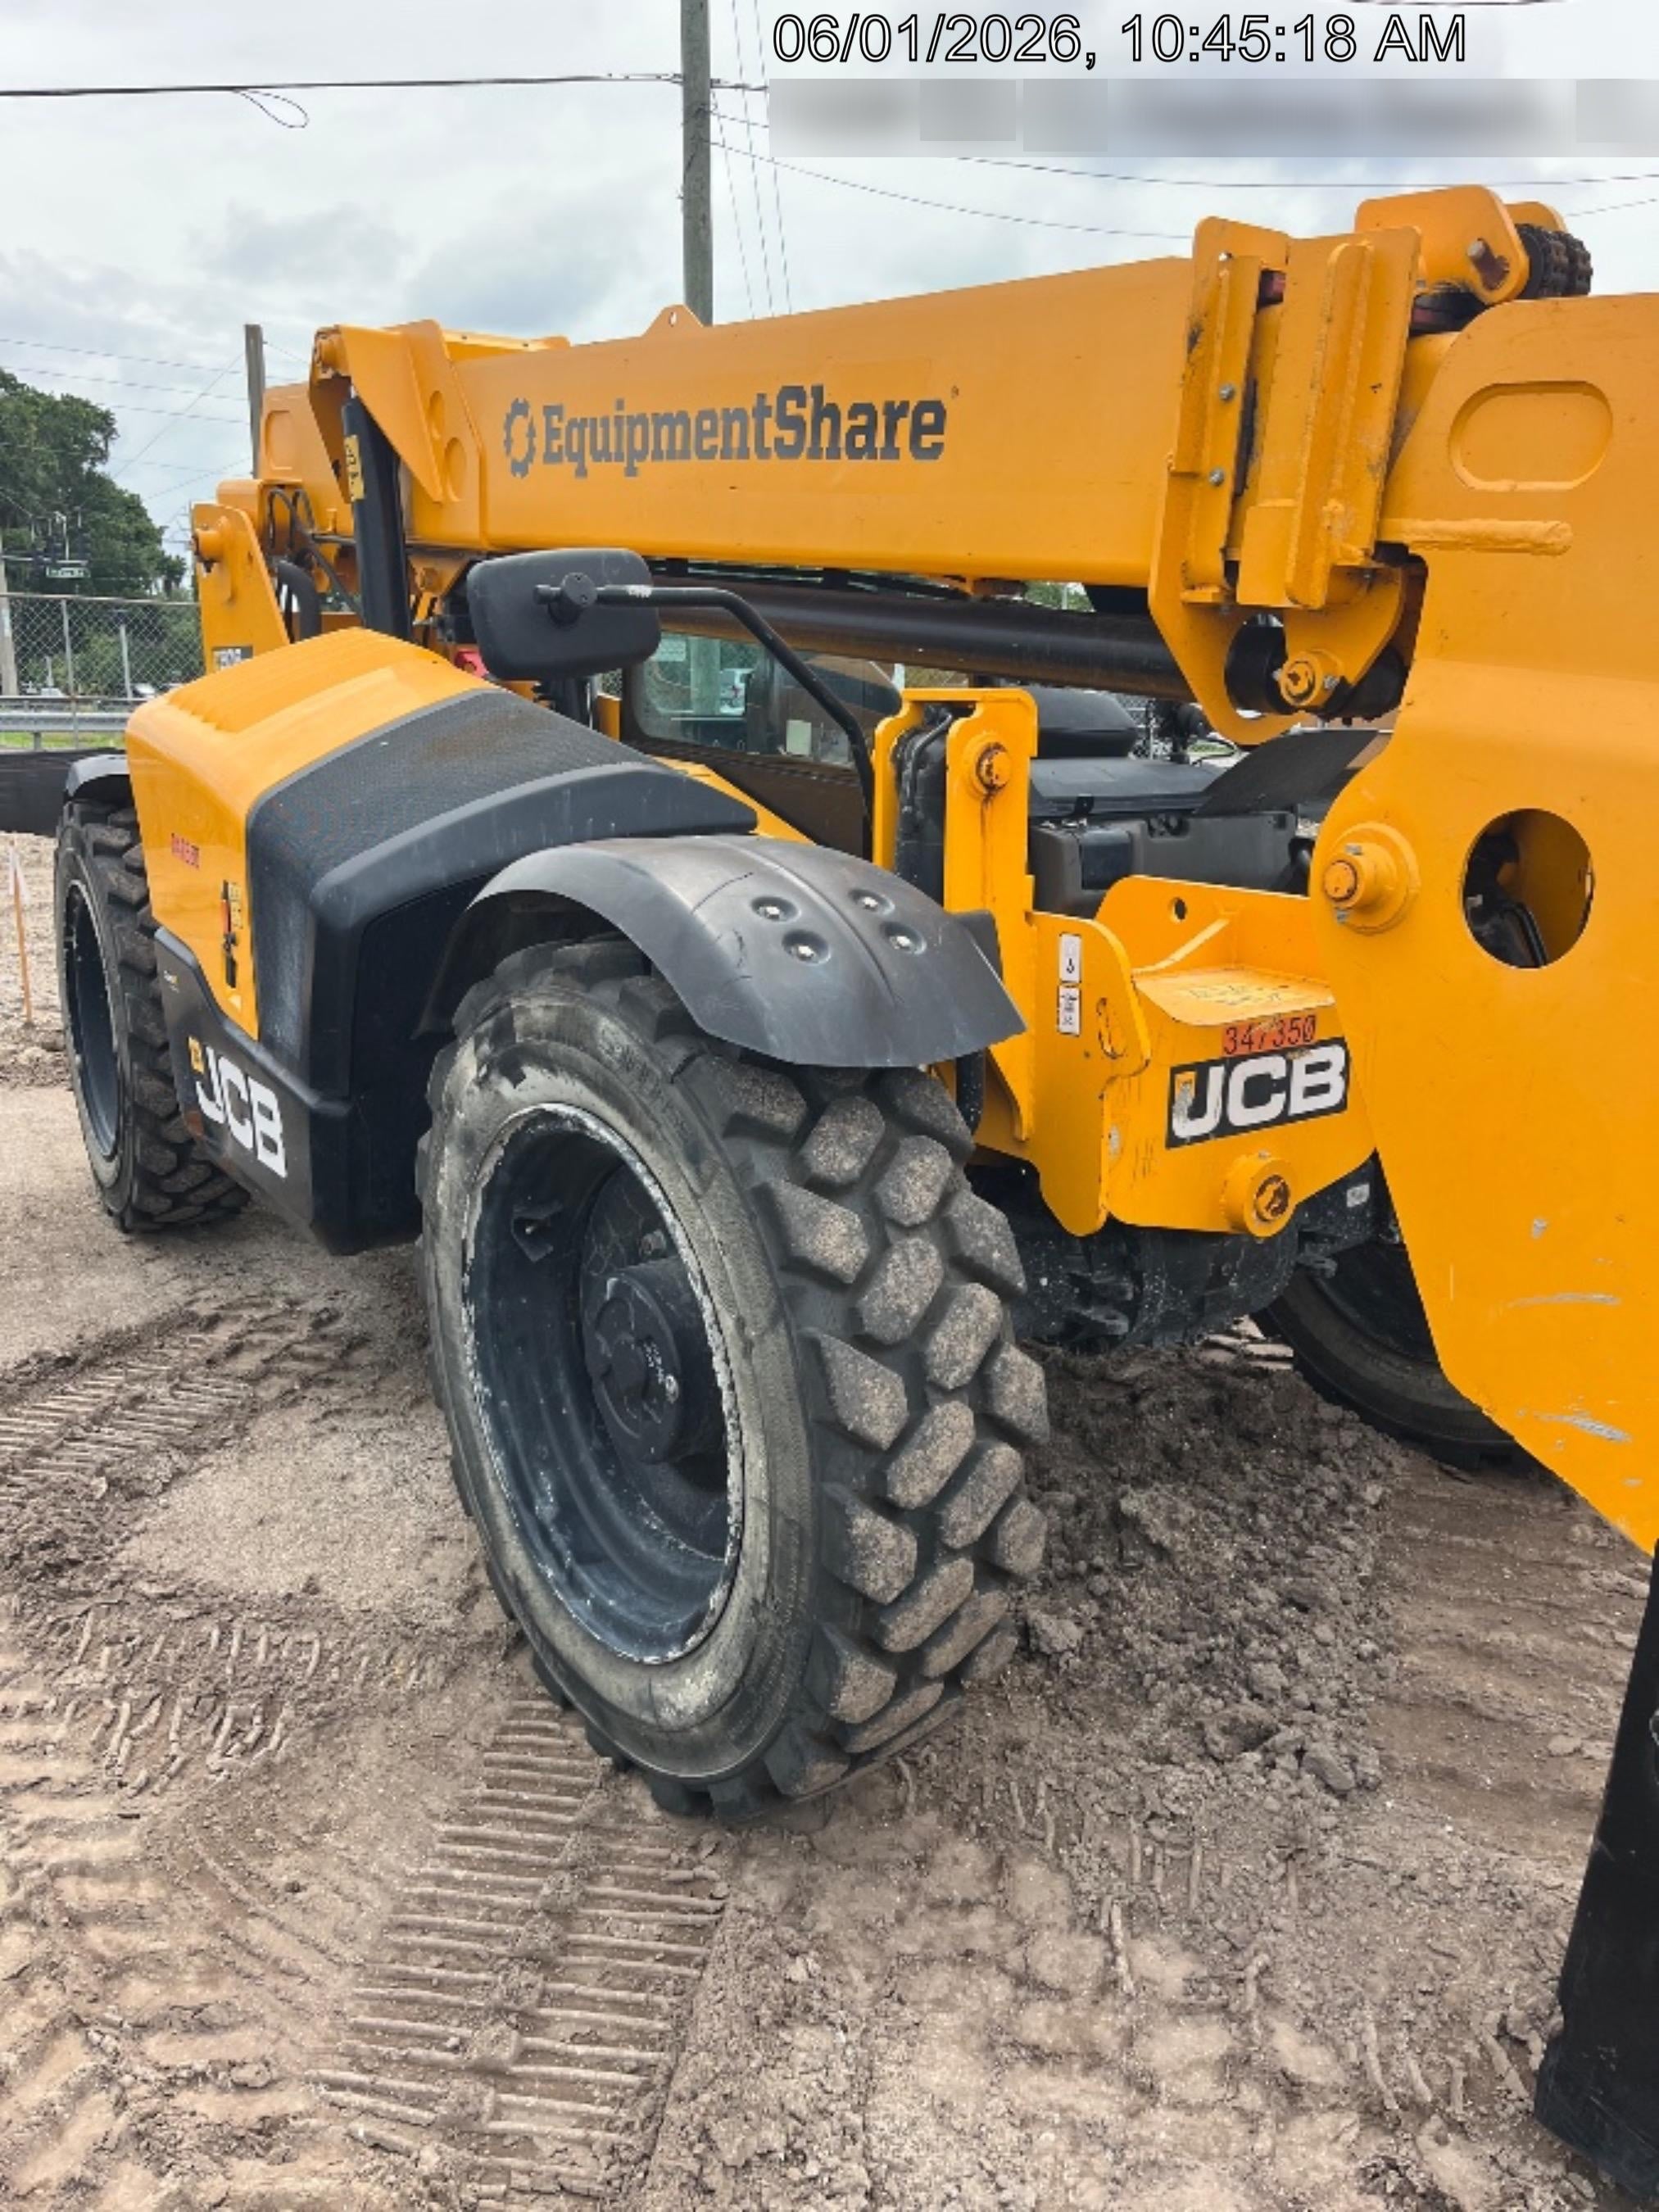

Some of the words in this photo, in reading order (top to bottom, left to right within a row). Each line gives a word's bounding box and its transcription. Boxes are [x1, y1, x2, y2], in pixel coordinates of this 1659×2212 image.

[542, 384, 947, 478] EquipmentShare
[195, 1045, 288, 1179] JCB
[1171, 1043, 1348, 1140] JCB
